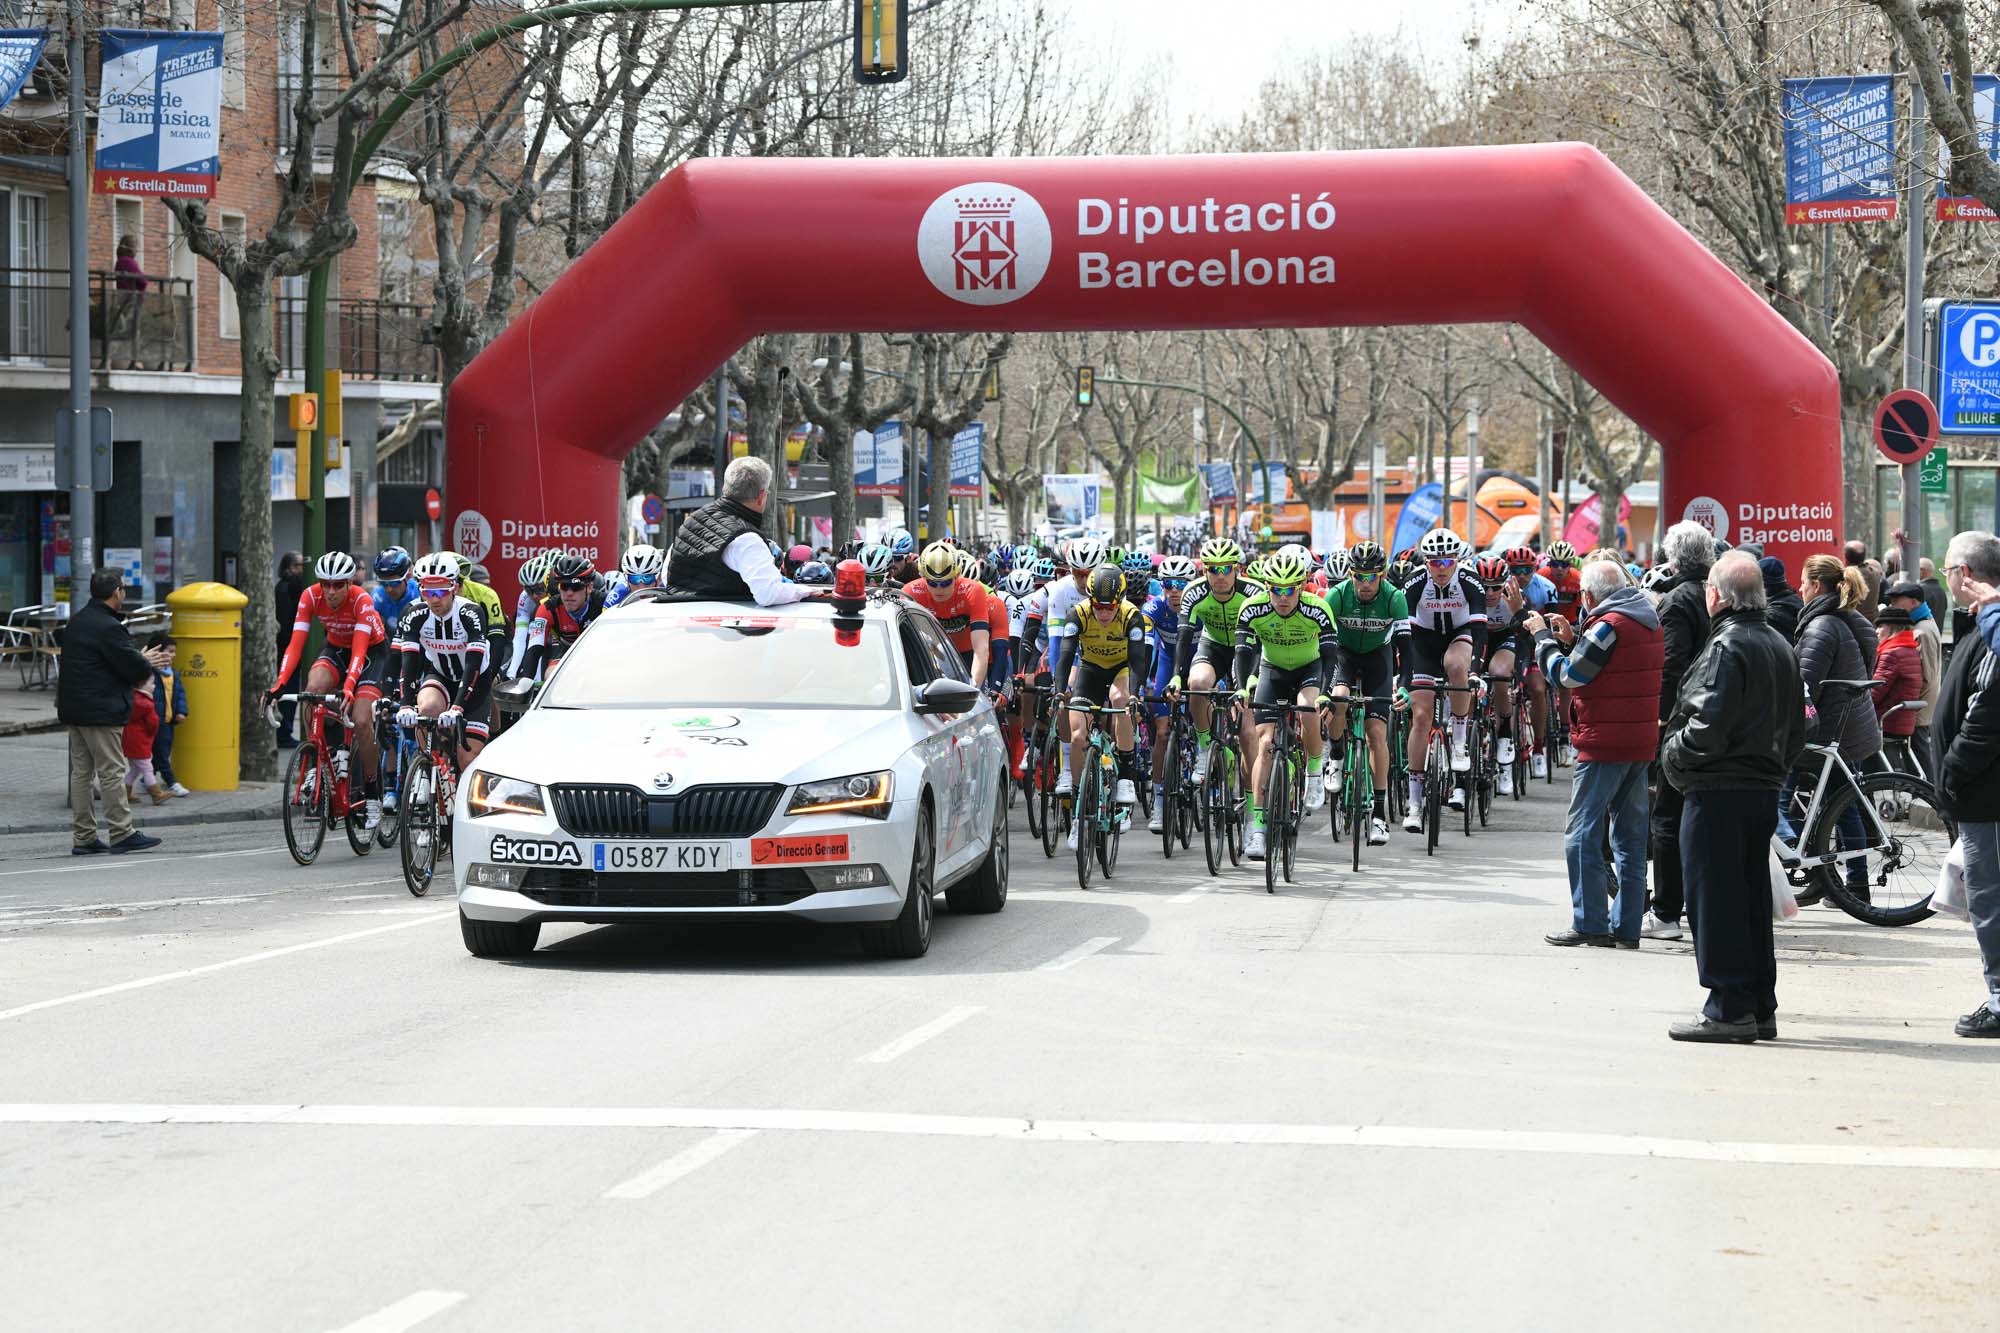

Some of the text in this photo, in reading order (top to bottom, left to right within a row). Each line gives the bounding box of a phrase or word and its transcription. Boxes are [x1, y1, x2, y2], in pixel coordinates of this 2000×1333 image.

[161, 60, 214, 81] ANIVERSARI
[170, 130, 211, 140] MATARÓ
[119, 177, 208, 194] Estrella Damm
[1078, 191, 1336, 244] Diputació
[1808, 205, 1888, 219] Estrella Damm
[1078, 248, 1336, 289] Barcelona
[1973, 319, 2000, 361] P
[1987, 349, 1995, 361] 6
[1982, 378, 2000, 388] FIR
[1958, 412, 1996, 424] LLIURE
[1925, 452, 1936, 466] P
[1739, 502, 1834, 525] Diputació
[502, 519, 600, 541] Diputació
[1739, 525, 1834, 544] Barcelona
[1181, 584, 1208, 616] MURIAS
[1240, 603, 1273, 623] MURIAS
[1300, 602, 1330, 627] MURIAS
[490, 836, 581, 864] ŠKODA
[611, 845, 721, 869] 0587 KDY
[776, 841, 847, 857] Direcció General
